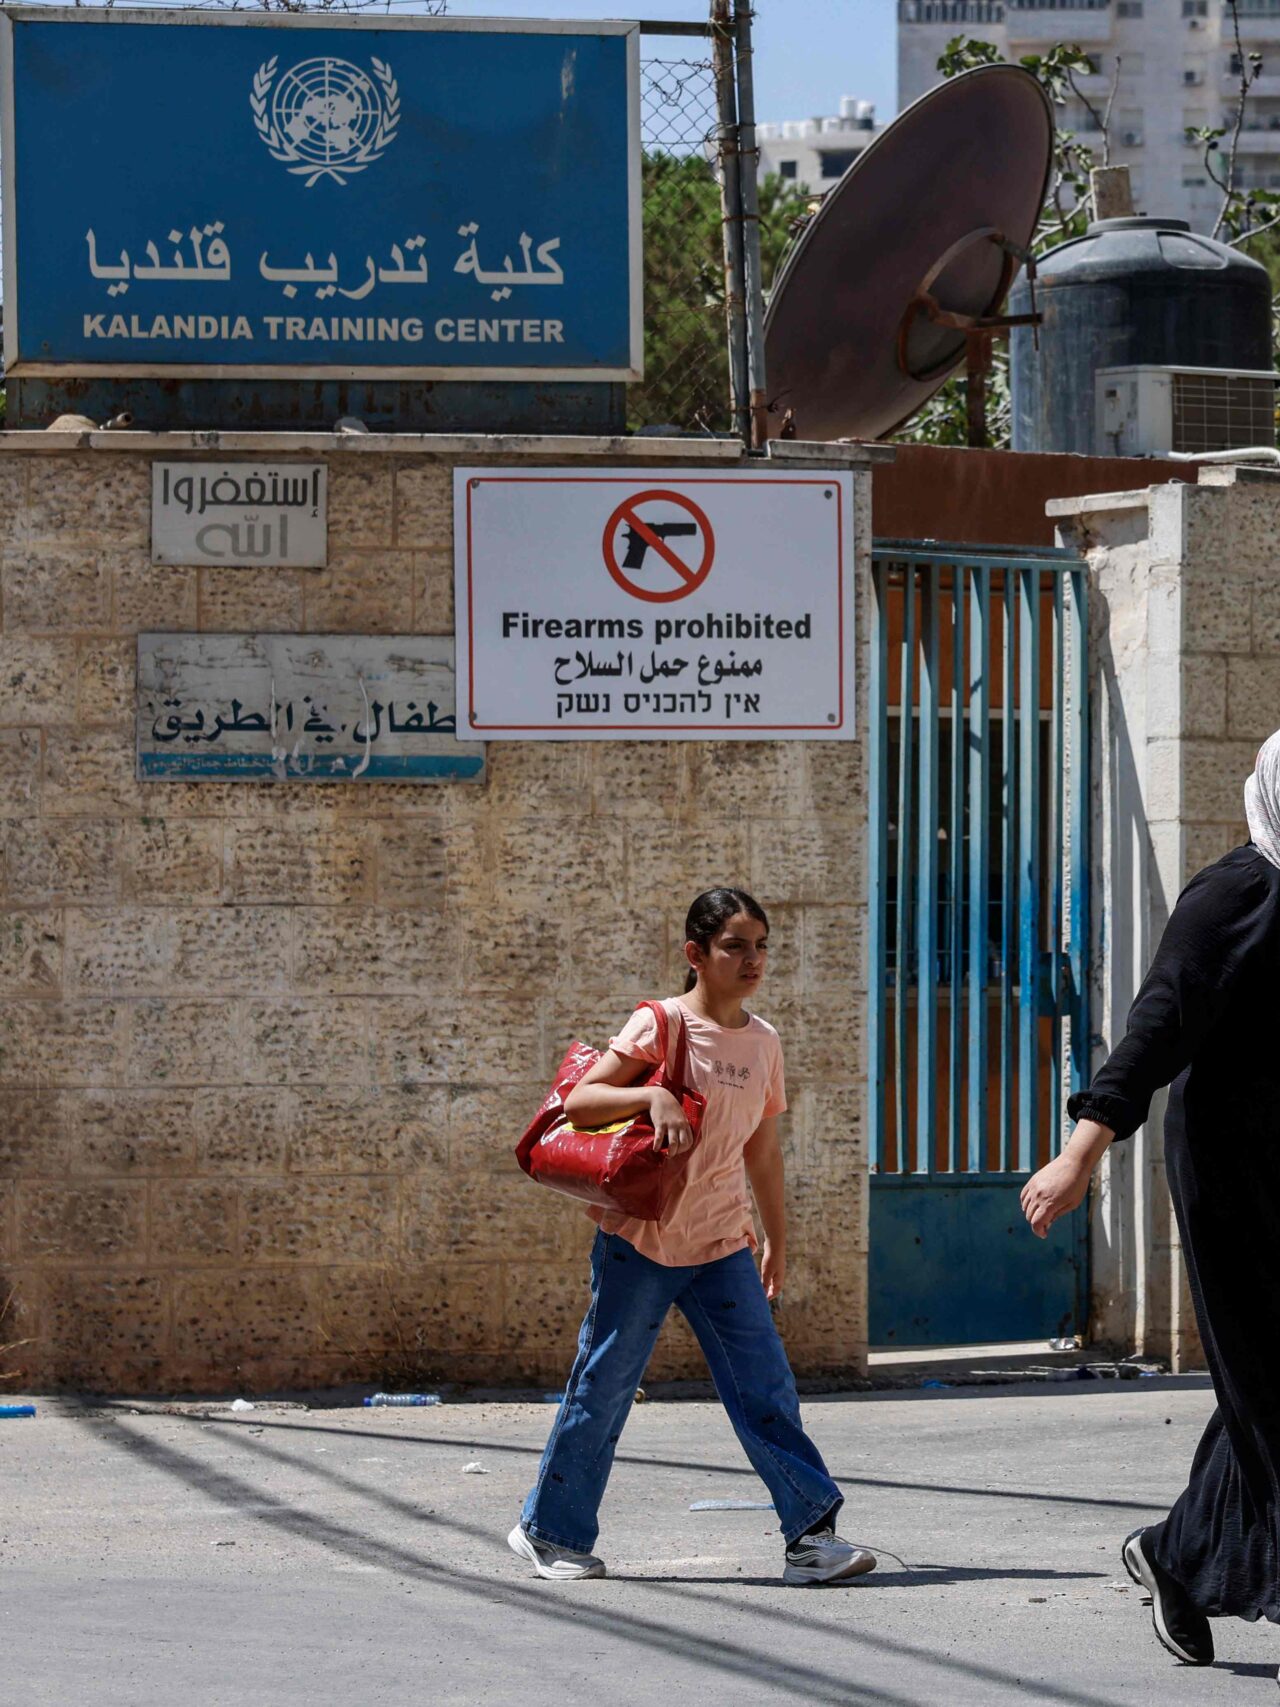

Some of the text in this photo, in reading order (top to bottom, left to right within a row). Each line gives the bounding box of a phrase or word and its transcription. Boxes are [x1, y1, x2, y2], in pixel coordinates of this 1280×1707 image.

[86, 221, 564, 302] كلية تدريب قلنديا
[83, 314, 565, 343] KALANDIA TRAINING CENTER
[502, 612, 812, 645] Firearms prohibited
[554, 650, 763, 685] ممنوع حمل السلاح
[152, 698, 294, 743] الطريق
[353, 699, 457, 743] طفال
[557, 690, 760, 719] אין להכניס נשק
